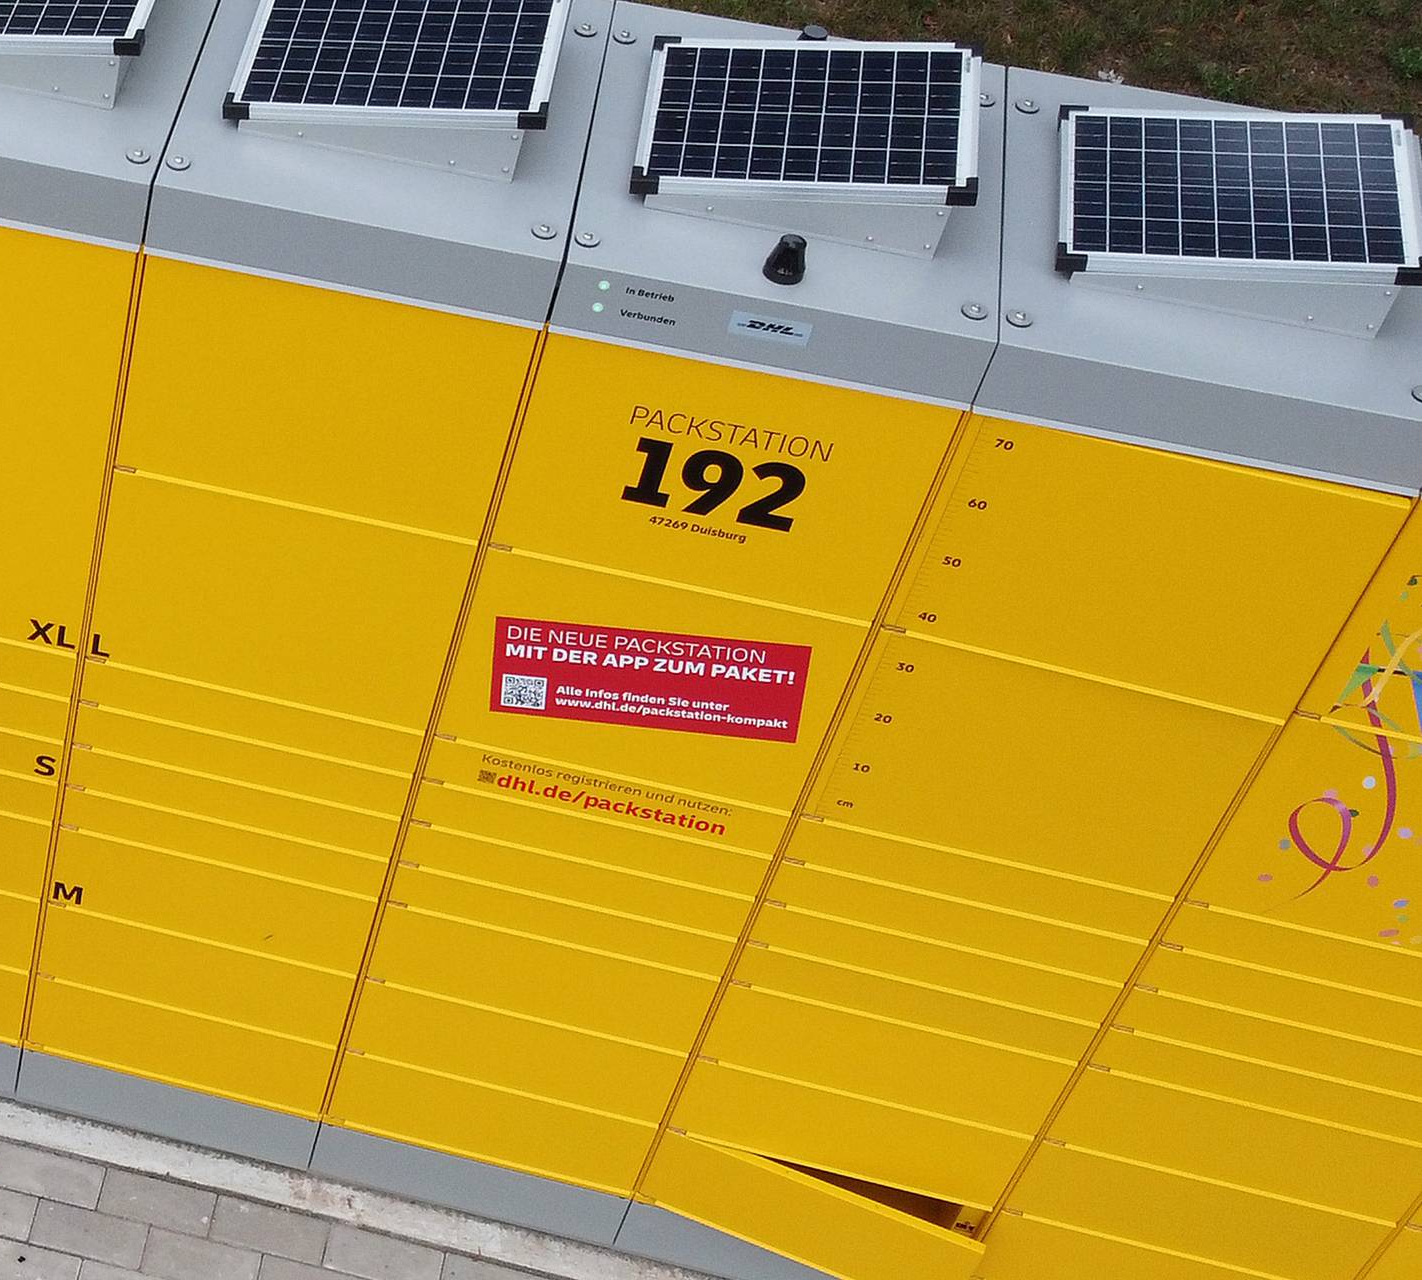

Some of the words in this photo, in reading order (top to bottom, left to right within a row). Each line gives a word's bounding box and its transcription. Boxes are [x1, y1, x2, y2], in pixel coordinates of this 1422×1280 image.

[625, 286, 636, 295] In
[638, 288, 675, 303] Betrieb
[620, 308, 676, 327] Verbunden
[746, 319, 795, 336] DHL
[629, 405, 834, 462] PACKSTATION
[994, 438, 1015, 451] 70
[621, 437, 806, 533] 192
[967, 498, 988, 511] 60
[649, 515, 688, 530] 47269
[690, 524, 747, 544] Duisburg
[941, 555, 962, 568] 50
[917, 611, 938, 624] 40
[27, 618, 76, 650] XL
[91, 633, 110, 658] L
[507, 625, 542, 643] DIE
[548, 629, 608, 648] NEUE
[614, 636, 767, 664] PACKSTATION
[505, 643, 547, 660] MIT
[552, 648, 598, 666] DER
[602, 653, 649, 671] APP
[653, 658, 705, 677] ZUM
[711, 664, 796, 685] PAKET!
[896, 662, 915, 674] 30
[556, 685, 582, 698] Alle
[585, 688, 619, 701] Infos
[622, 691, 665, 705] finden
[668, 697, 689, 708] Sie
[692, 700, 730, 712] unter
[554, 696, 789, 729] www.dhl.de/packstation-kompakt
[873, 713, 893, 725] 20
[33, 755, 56, 777] S
[852, 763, 871, 774] 10
[482, 753, 553, 778] Kostenlos
[556, 770, 642, 796] registrieren
[645, 788, 675, 804] und
[677, 797, 733, 817] nutzen:
[496, 774, 726, 836] dhl.de/packstation
[836, 798, 854, 810] cm
[52, 881, 84, 905] M
